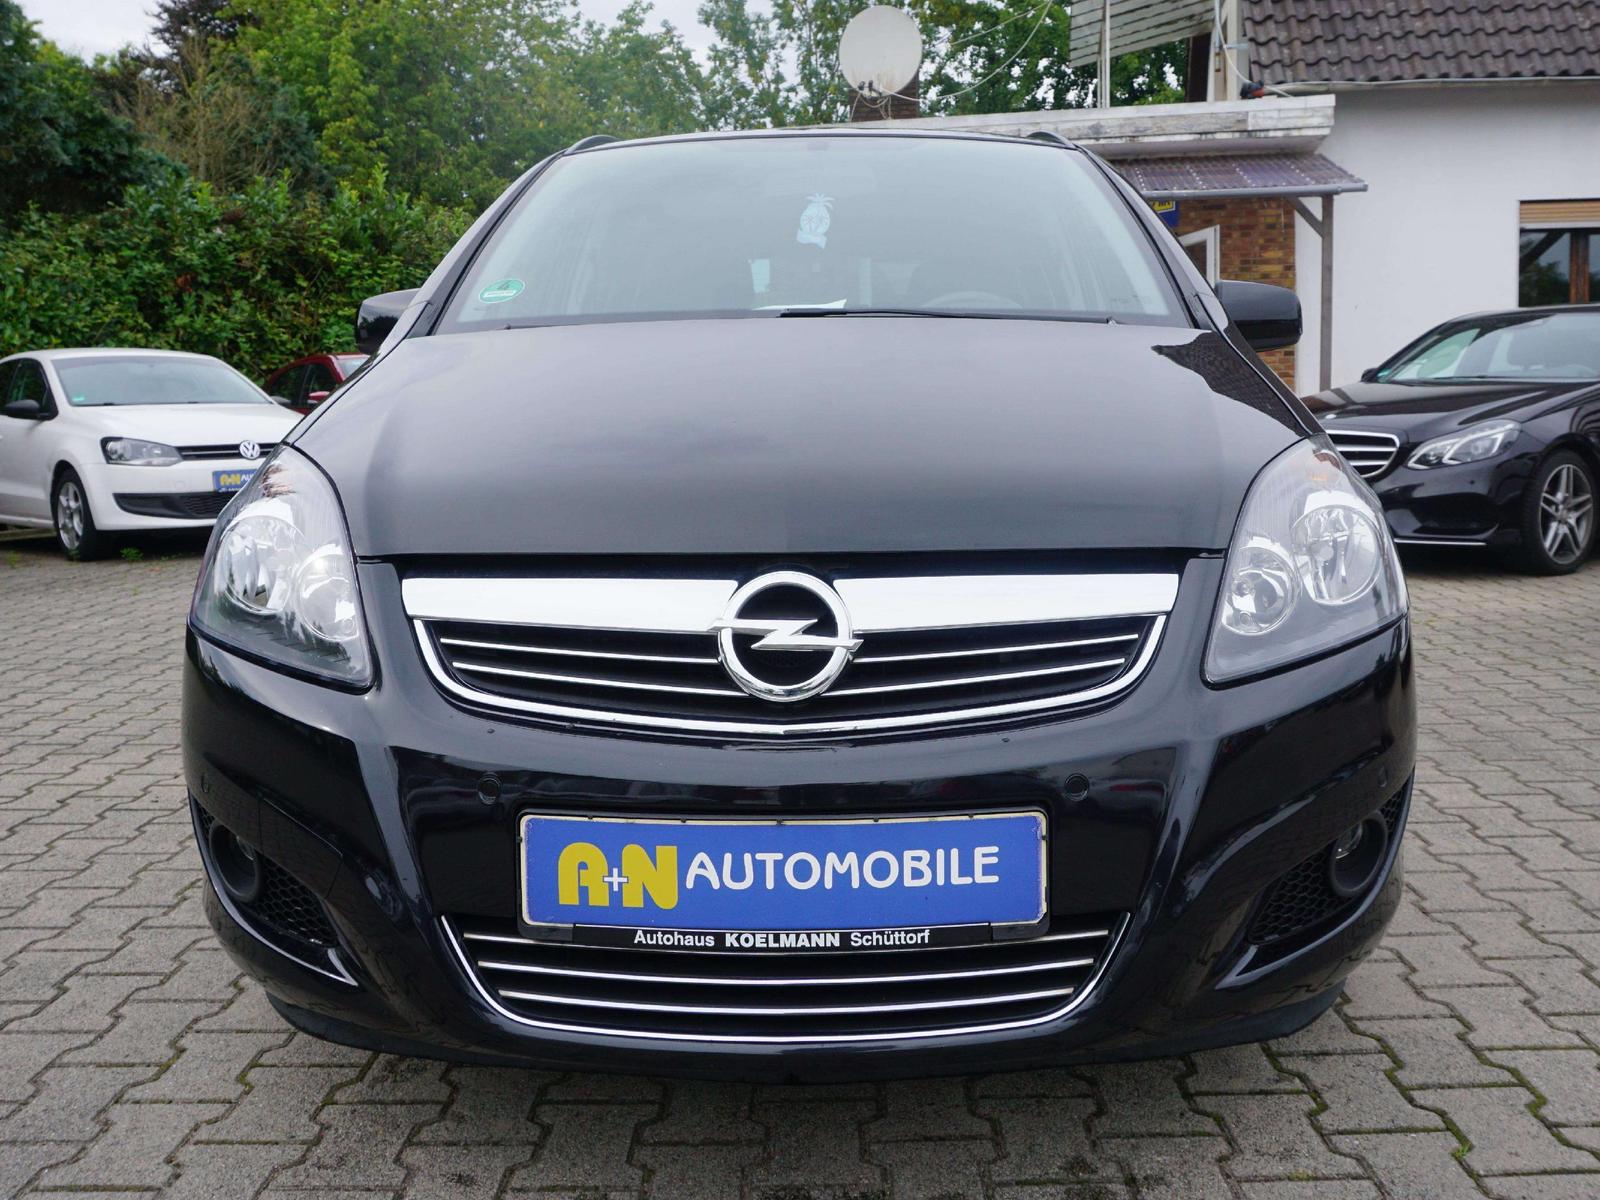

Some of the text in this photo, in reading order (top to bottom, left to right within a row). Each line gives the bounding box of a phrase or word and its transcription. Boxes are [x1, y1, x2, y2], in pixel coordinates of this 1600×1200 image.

[240, 441, 260, 459] VW
[558, 842, 999, 910] A+N AUTOMOBILE
[634, 930, 930, 948] Autohaus KOELMANN Schüttorf
